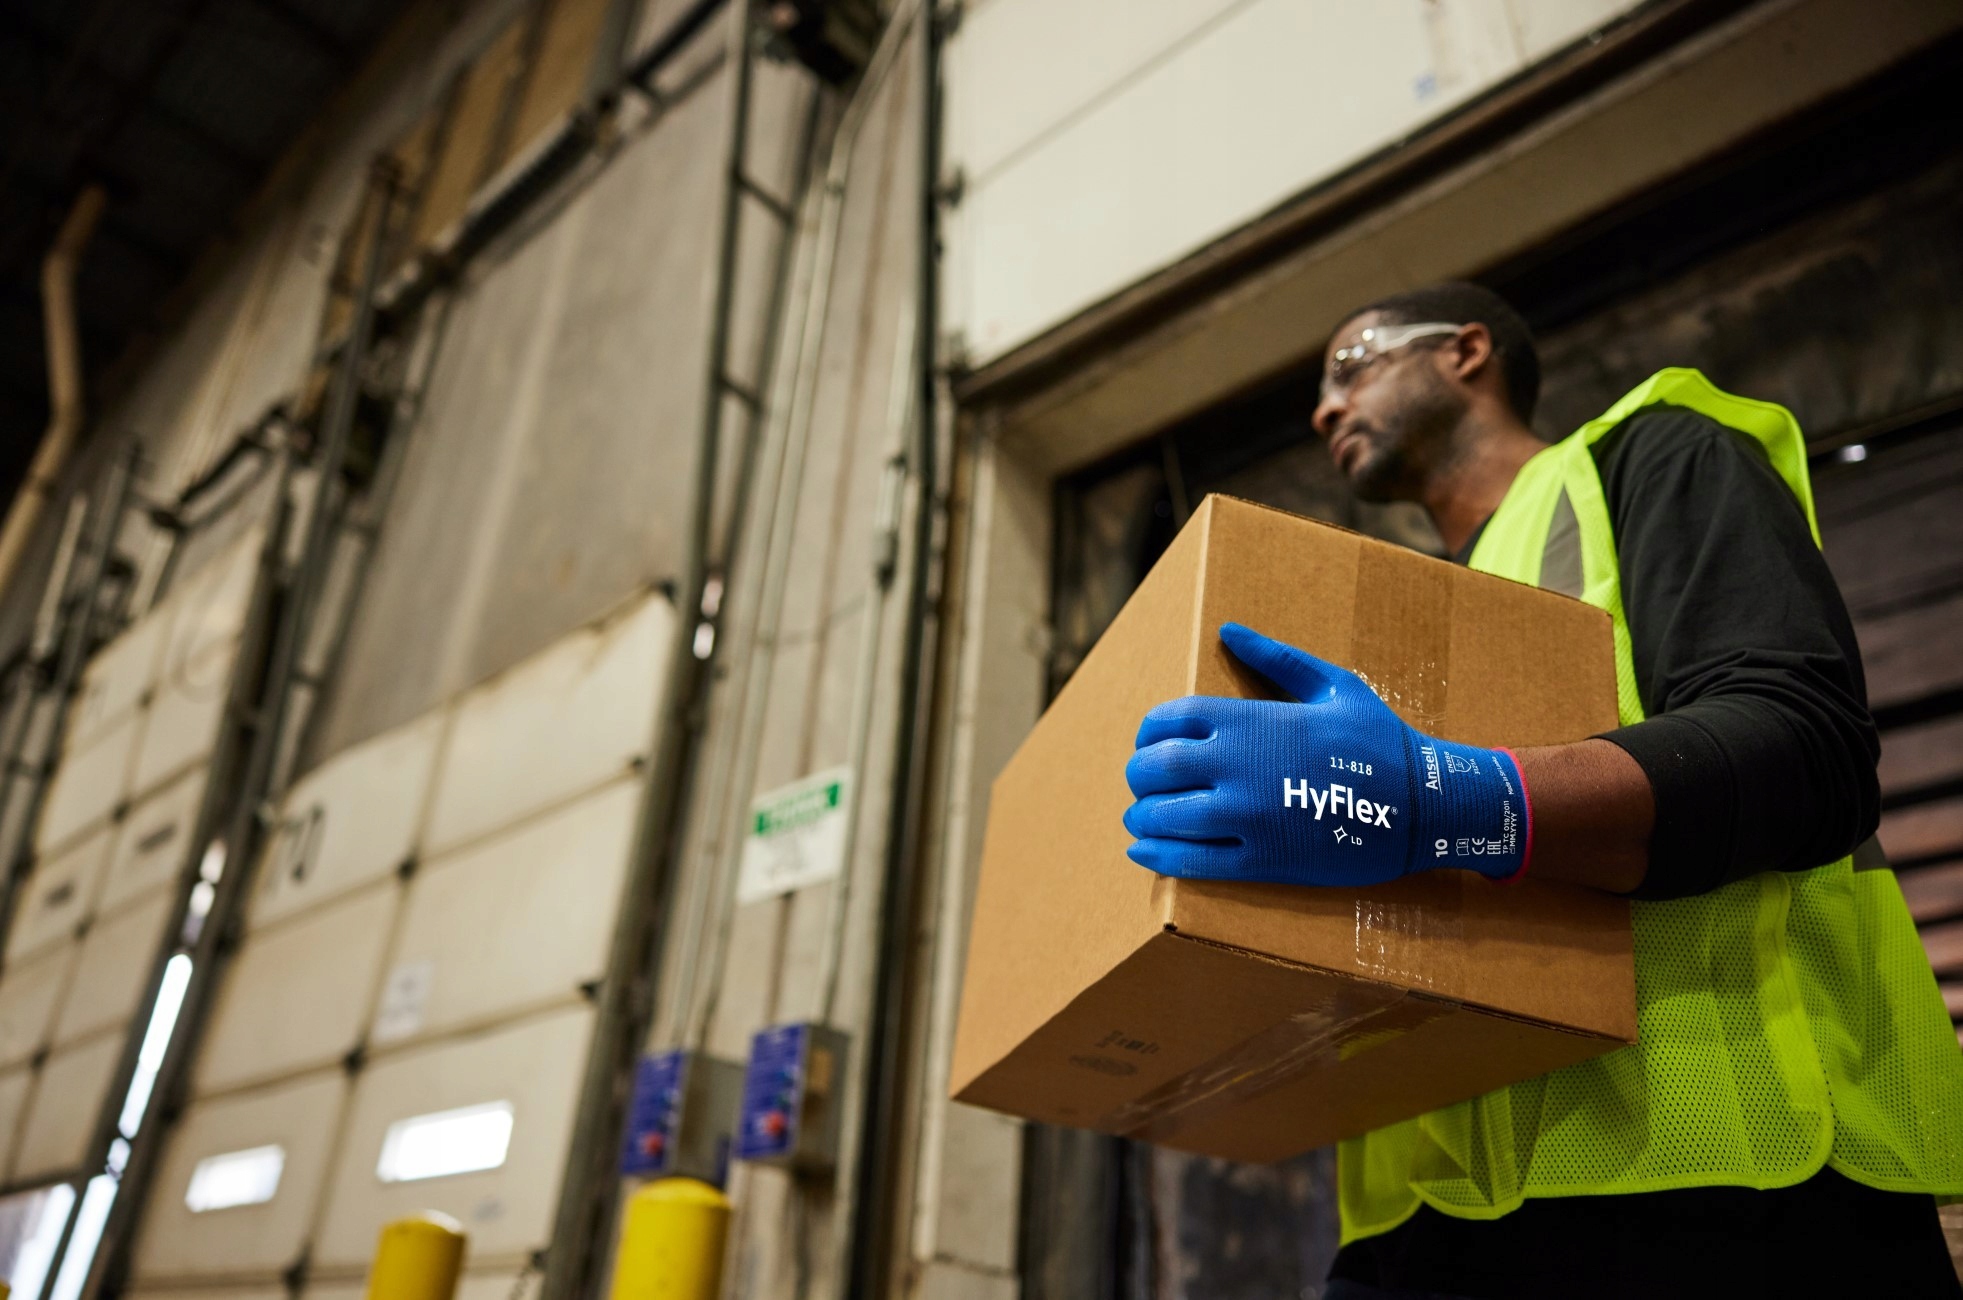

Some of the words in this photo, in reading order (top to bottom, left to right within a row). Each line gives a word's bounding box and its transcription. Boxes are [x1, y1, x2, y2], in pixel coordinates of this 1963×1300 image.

[1330, 757, 1373, 776] 11-818
[1421, 746, 1439, 790] Ansell
[1443, 751, 1455, 773] EN388
[1351, 836, 1363, 846] LD
[1471, 837, 1486, 855] CE
[1502, 833, 1509, 843] TC
[1434, 838, 1449, 858] 10
